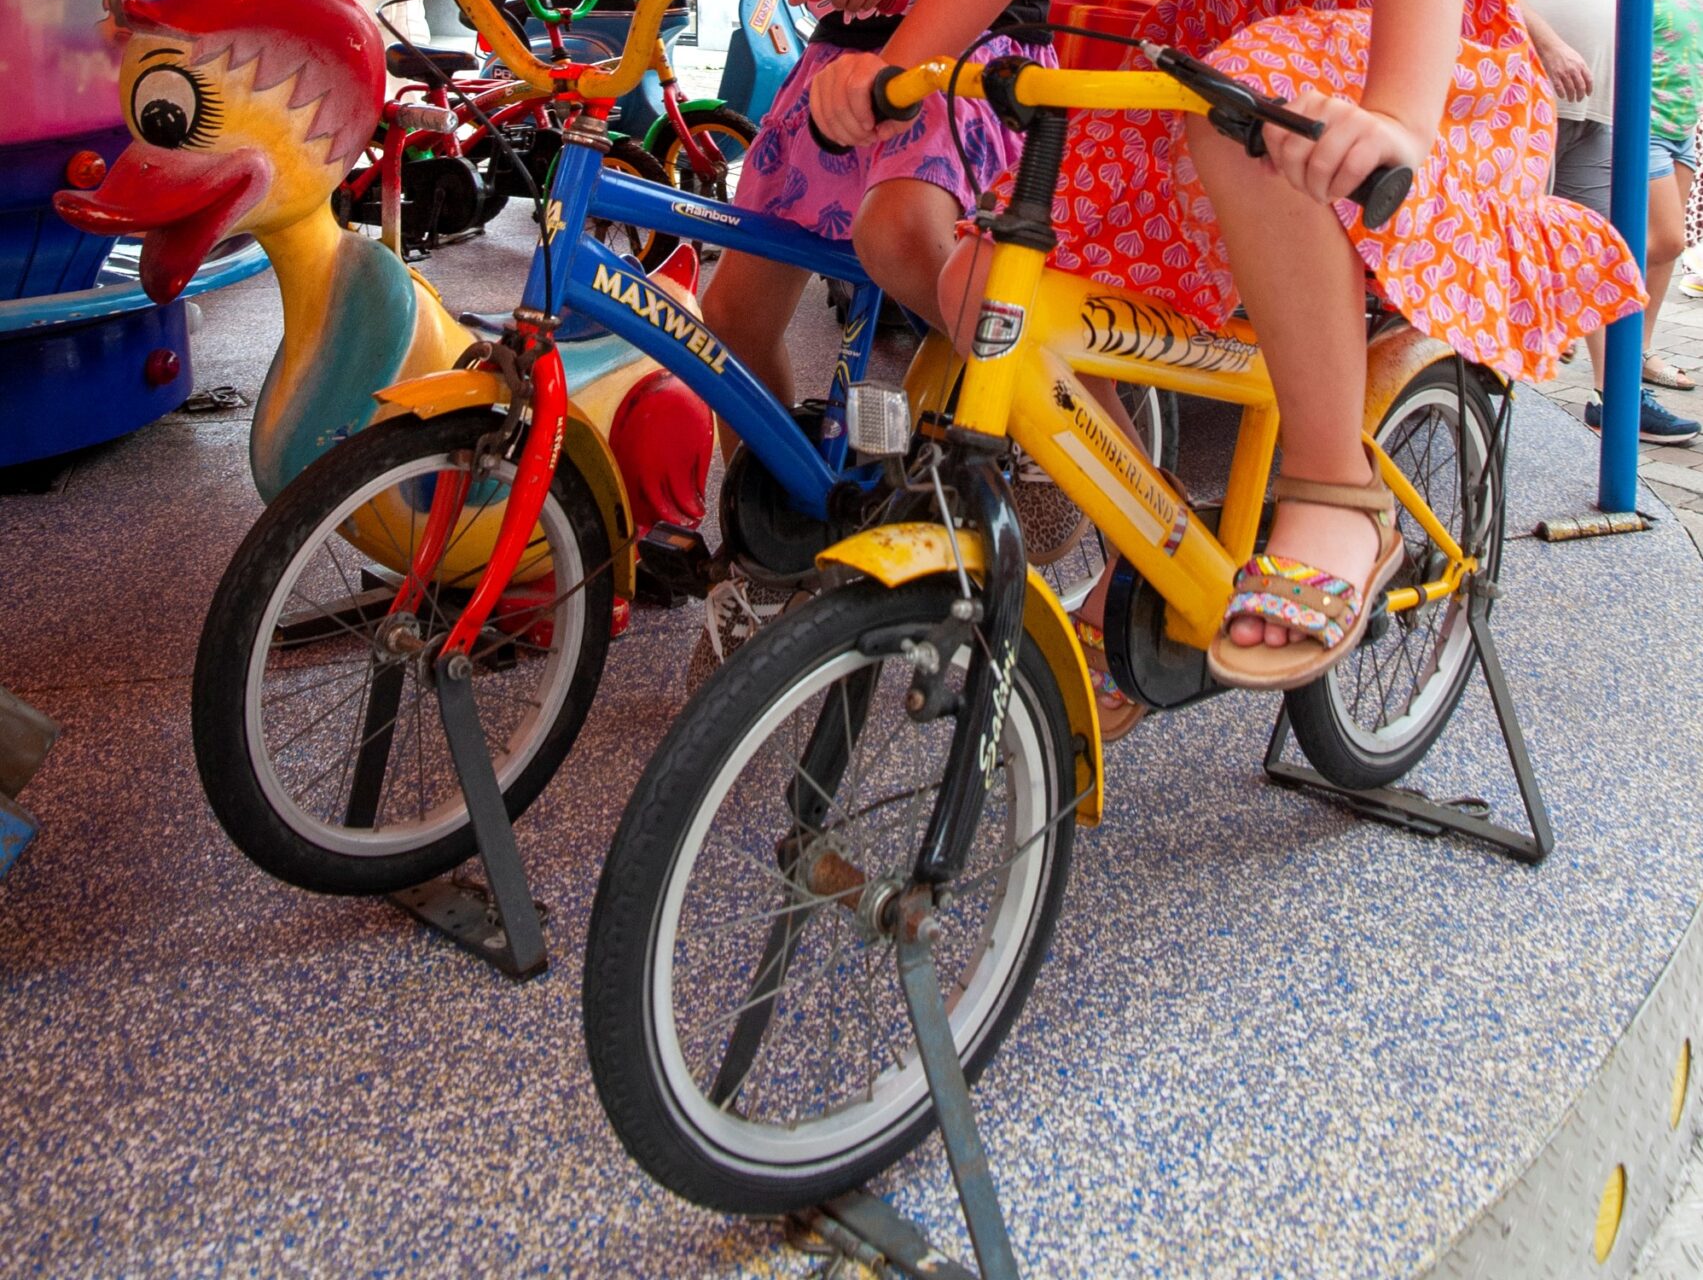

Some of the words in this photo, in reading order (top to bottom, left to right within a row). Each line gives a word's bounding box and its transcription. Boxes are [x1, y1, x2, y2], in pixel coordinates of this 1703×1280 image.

[686, 202, 741, 226] Rainbow
[592, 263, 729, 375] MAXWELL
[1190, 328, 1258, 356] Safari
[1074, 407, 1174, 524] CUMBERLAND
[979, 639, 1015, 790] Safari
